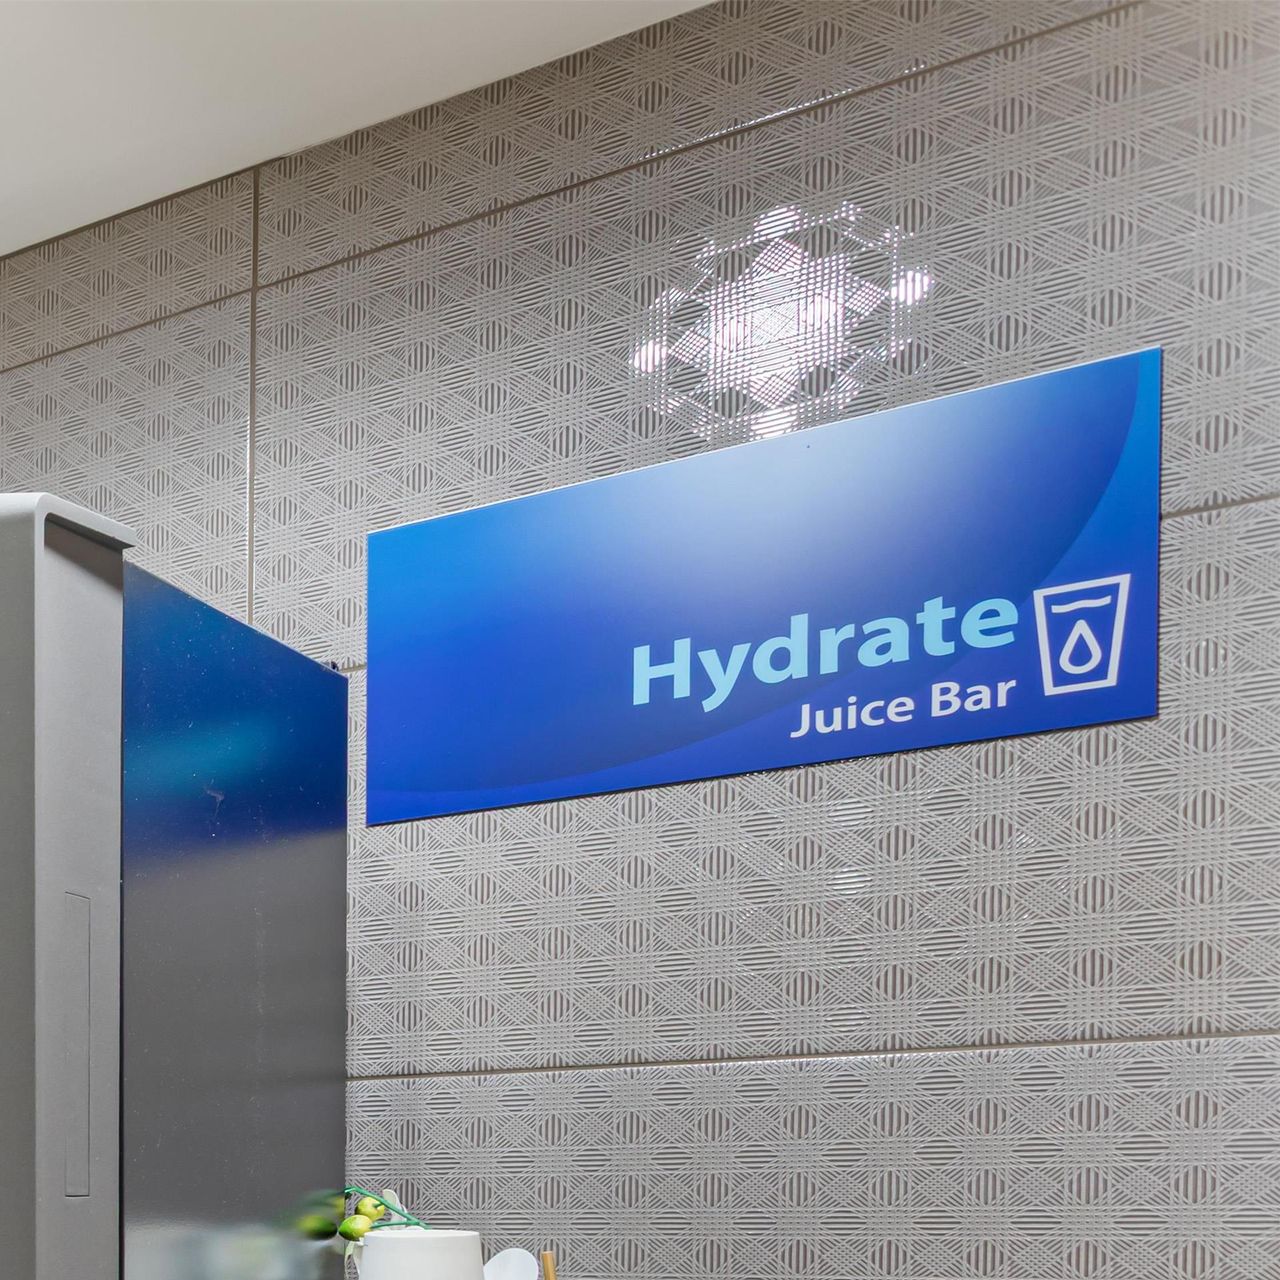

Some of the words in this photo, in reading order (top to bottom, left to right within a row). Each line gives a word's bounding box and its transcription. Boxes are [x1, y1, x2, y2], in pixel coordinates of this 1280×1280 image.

[632, 596, 1020, 714] Hydrate
[790, 694, 916, 738] Juice
[930, 678, 1018, 718] Bar
